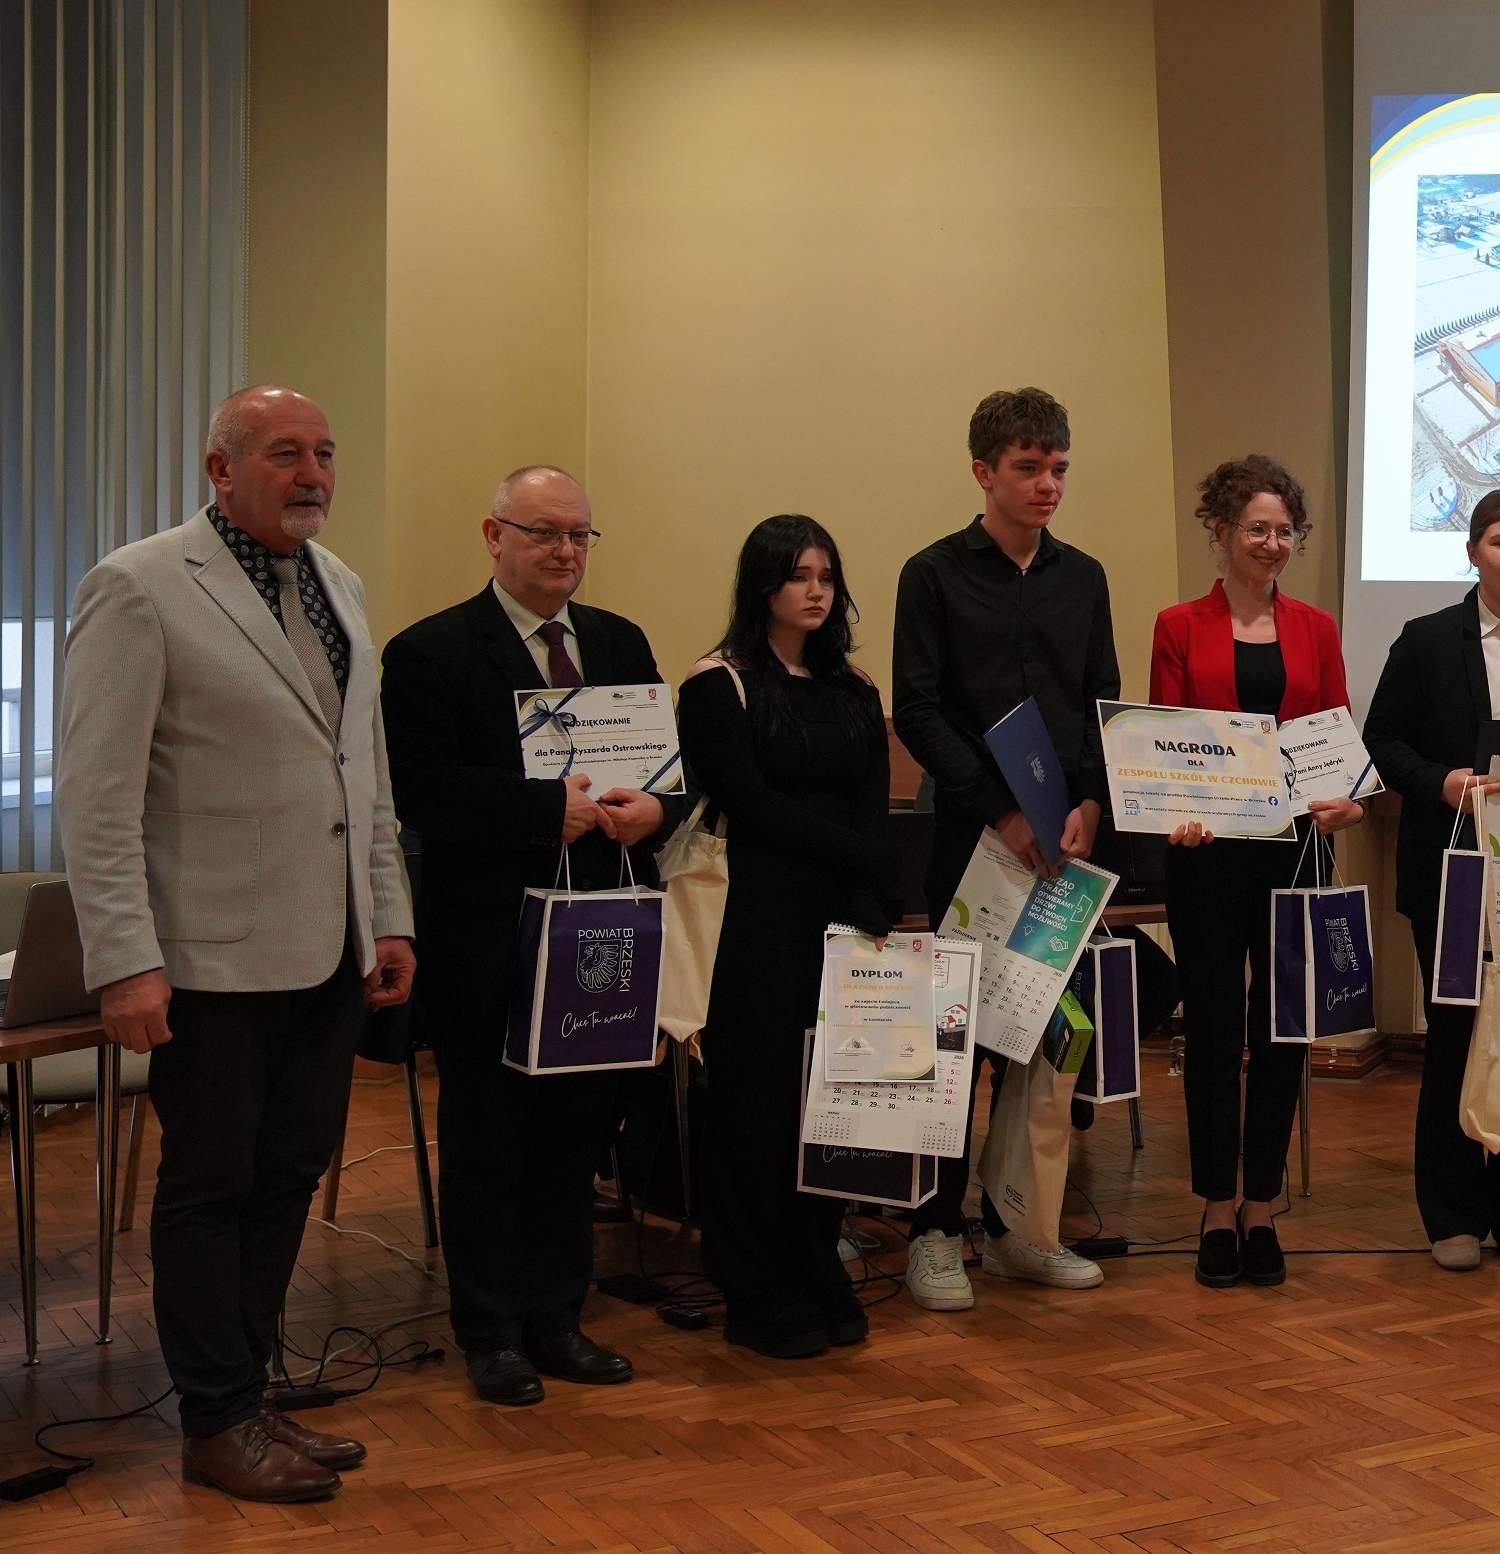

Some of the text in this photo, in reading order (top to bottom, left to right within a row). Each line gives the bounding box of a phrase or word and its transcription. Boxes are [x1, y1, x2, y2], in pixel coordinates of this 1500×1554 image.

[570, 717, 631, 728] DZIĘKOWANIE
[534, 742, 668, 757] dla Pana Ryszarda Ostrowskiego
[1154, 739, 1237, 757] NAGRODA
[1285, 738, 1329, 754] ODZIĘKOWANIE
[1187, 759, 1205, 767] DLA
[1308, 763, 1323, 773] Anny
[1116, 767, 1279, 788] ZESPOŁU SZKÓŁ W CZCHOWIE
[1041, 880, 1071, 898] PRACY
[1034, 896, 1057, 911] DRZWI
[1037, 890, 1075, 909] OTWIERAMY
[1030, 903, 1068, 923] DO TWOICH
[1325, 918, 1341, 927] POWIAT
[577, 928, 623, 940] POWIAT
[1340, 917, 1360, 971] BRZESKI
[619, 927, 634, 992] BRZESKI
[851, 969, 903, 979] DYPLOM
